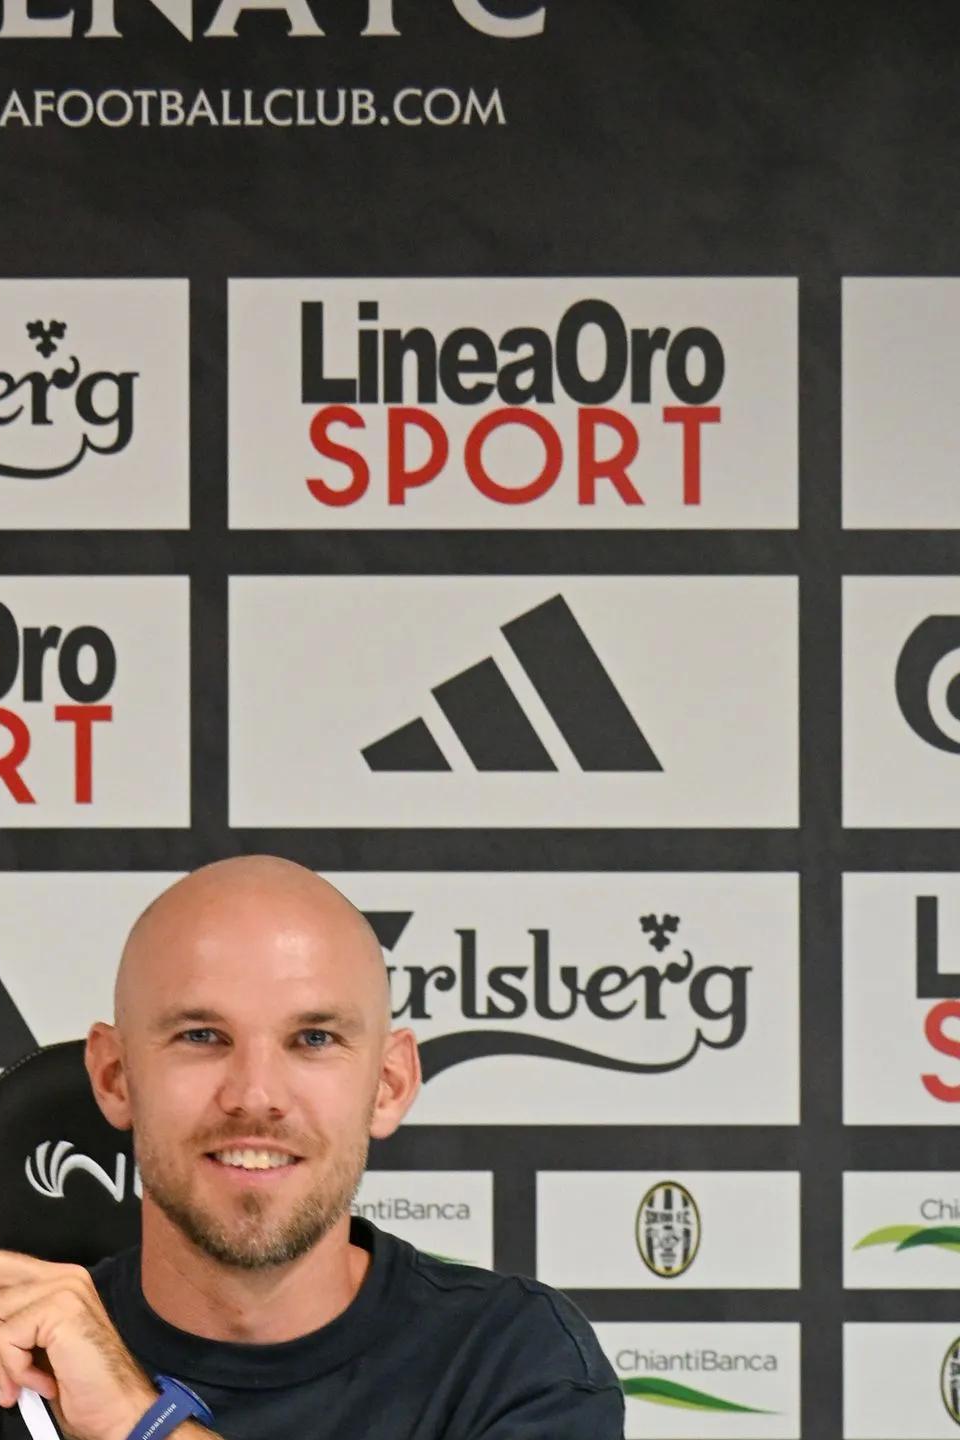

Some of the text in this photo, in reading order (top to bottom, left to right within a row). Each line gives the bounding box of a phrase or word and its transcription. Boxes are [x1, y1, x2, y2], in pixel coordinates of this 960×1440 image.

[300, 299, 726, 405] LineaOro
[306, 404, 722, 507] SPORT
[364, 912, 753, 1050] rlsberg
[615, 1349, 778, 1371] ChiantiBanca
